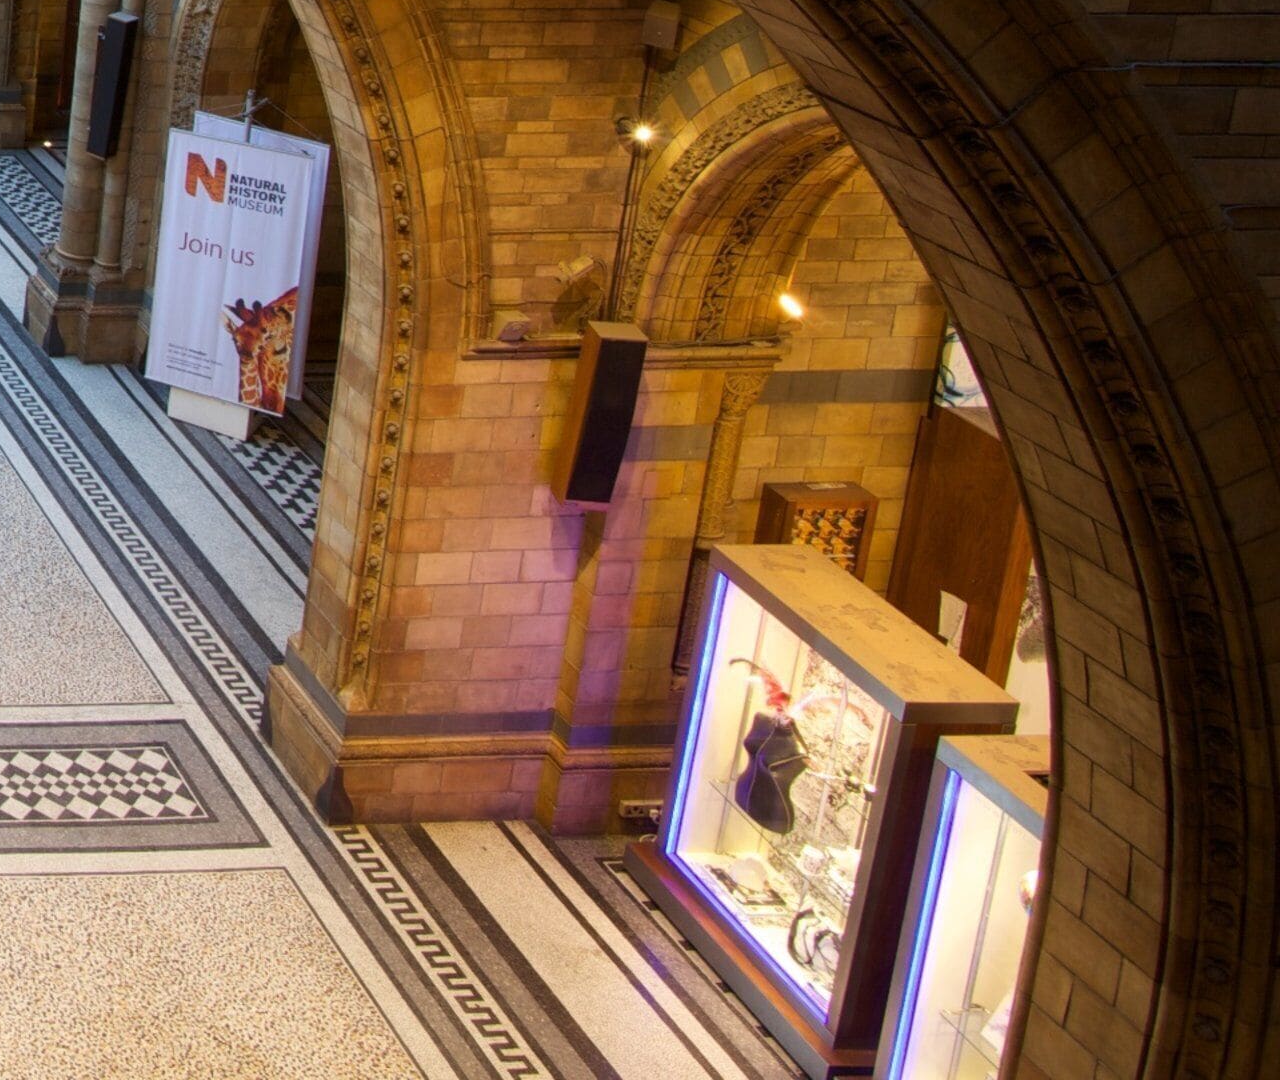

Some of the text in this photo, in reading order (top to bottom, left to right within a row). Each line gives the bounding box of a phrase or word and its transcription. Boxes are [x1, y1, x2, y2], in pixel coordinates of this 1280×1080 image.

[185, 152, 227, 203] N
[230, 174, 287, 194] NATURAL
[228, 185, 286, 204] HISTORY
[227, 196, 284, 216] MUSEUM
[178, 232, 255, 267] Join us
